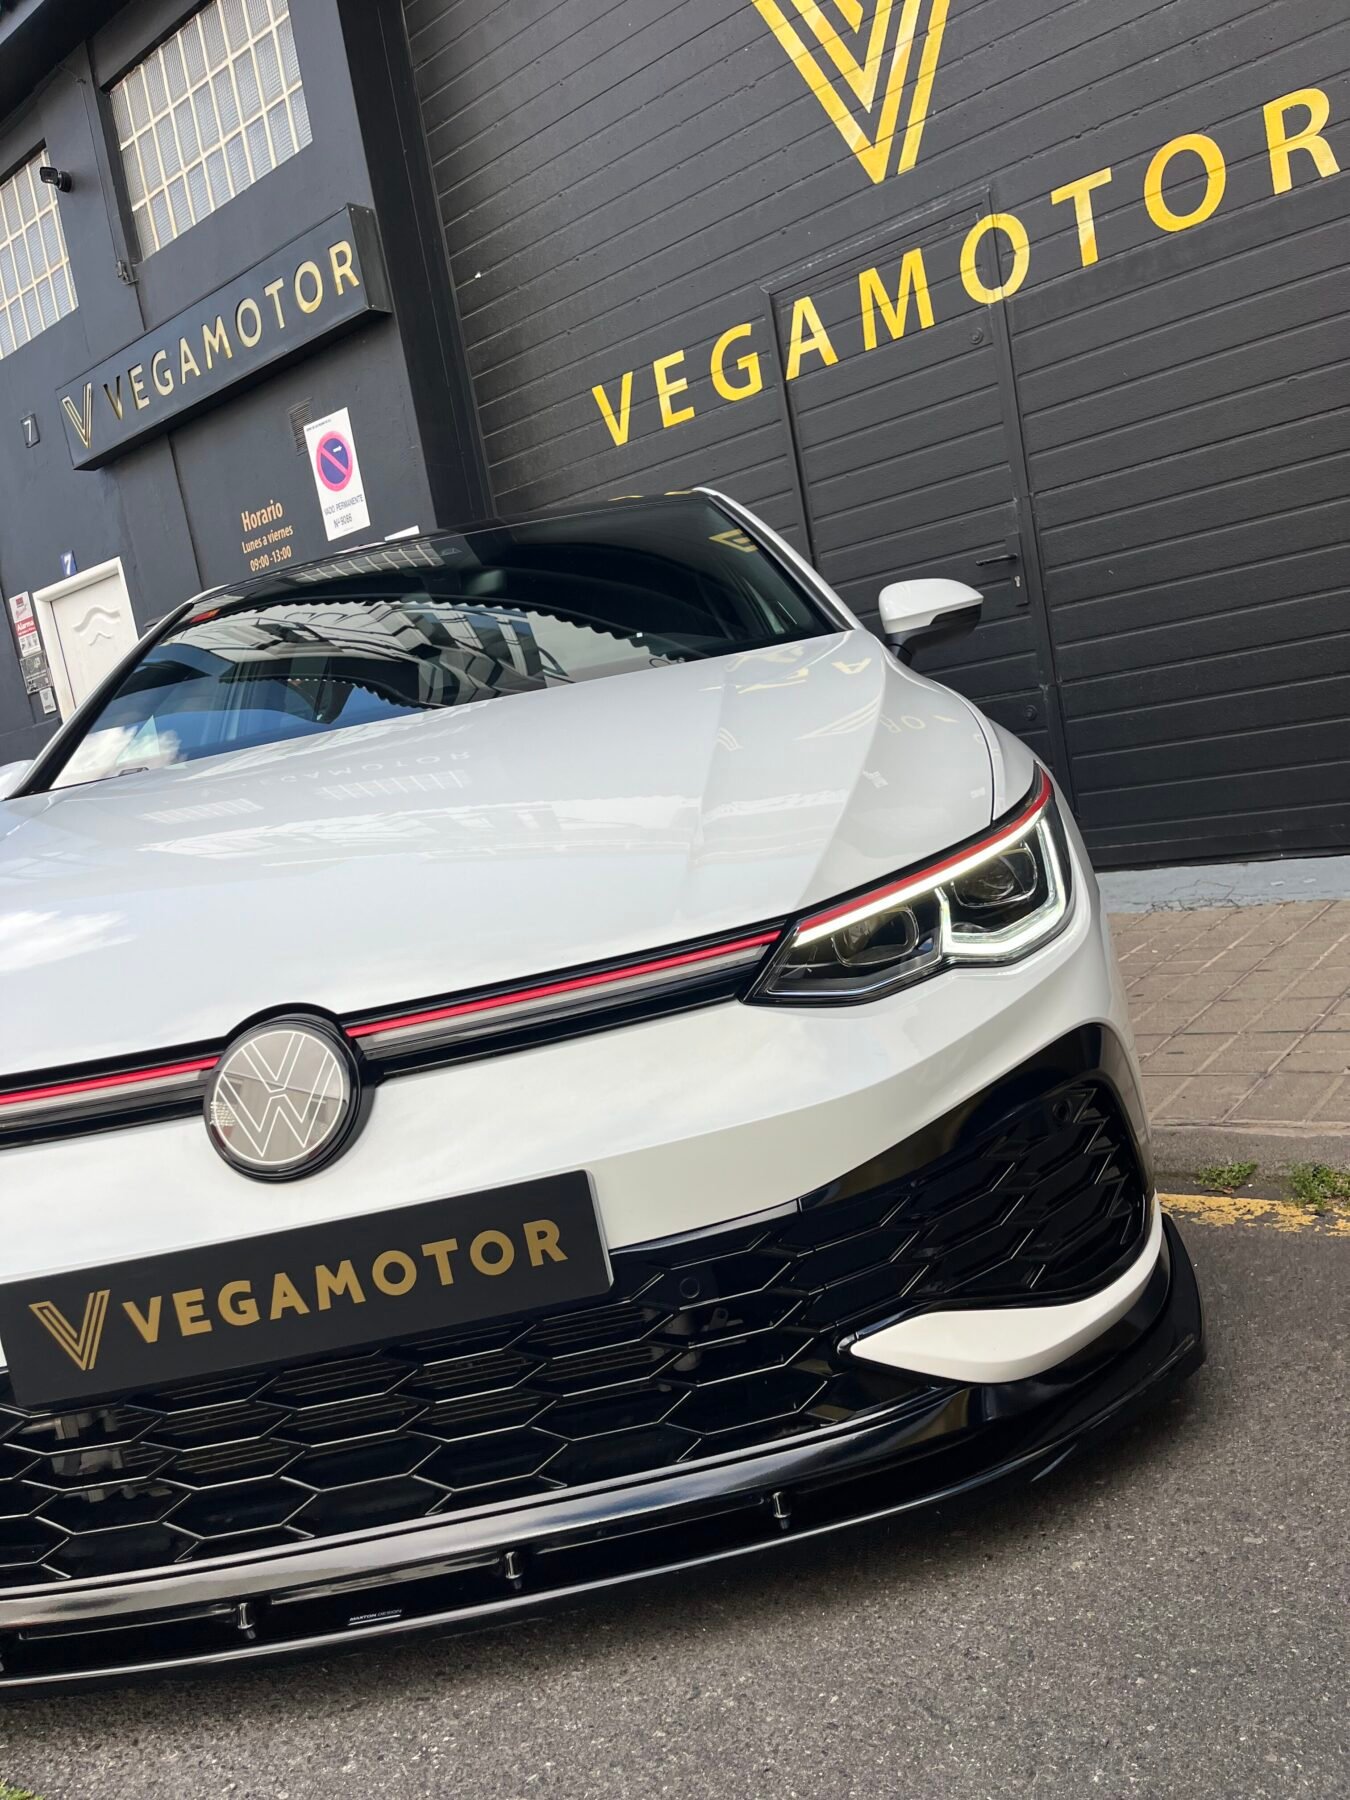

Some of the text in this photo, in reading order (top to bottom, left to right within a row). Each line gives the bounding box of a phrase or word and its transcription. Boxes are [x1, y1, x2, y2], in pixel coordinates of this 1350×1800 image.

[592, 88, 1340, 446] VEGAMOTOR
[103, 240, 360, 421] VEGAMOTOR
[241, 499, 283, 532] Horario
[242, 525, 293, 554] Lunes a viernes
[122, 1219, 568, 1343] VEGAMOTOR
